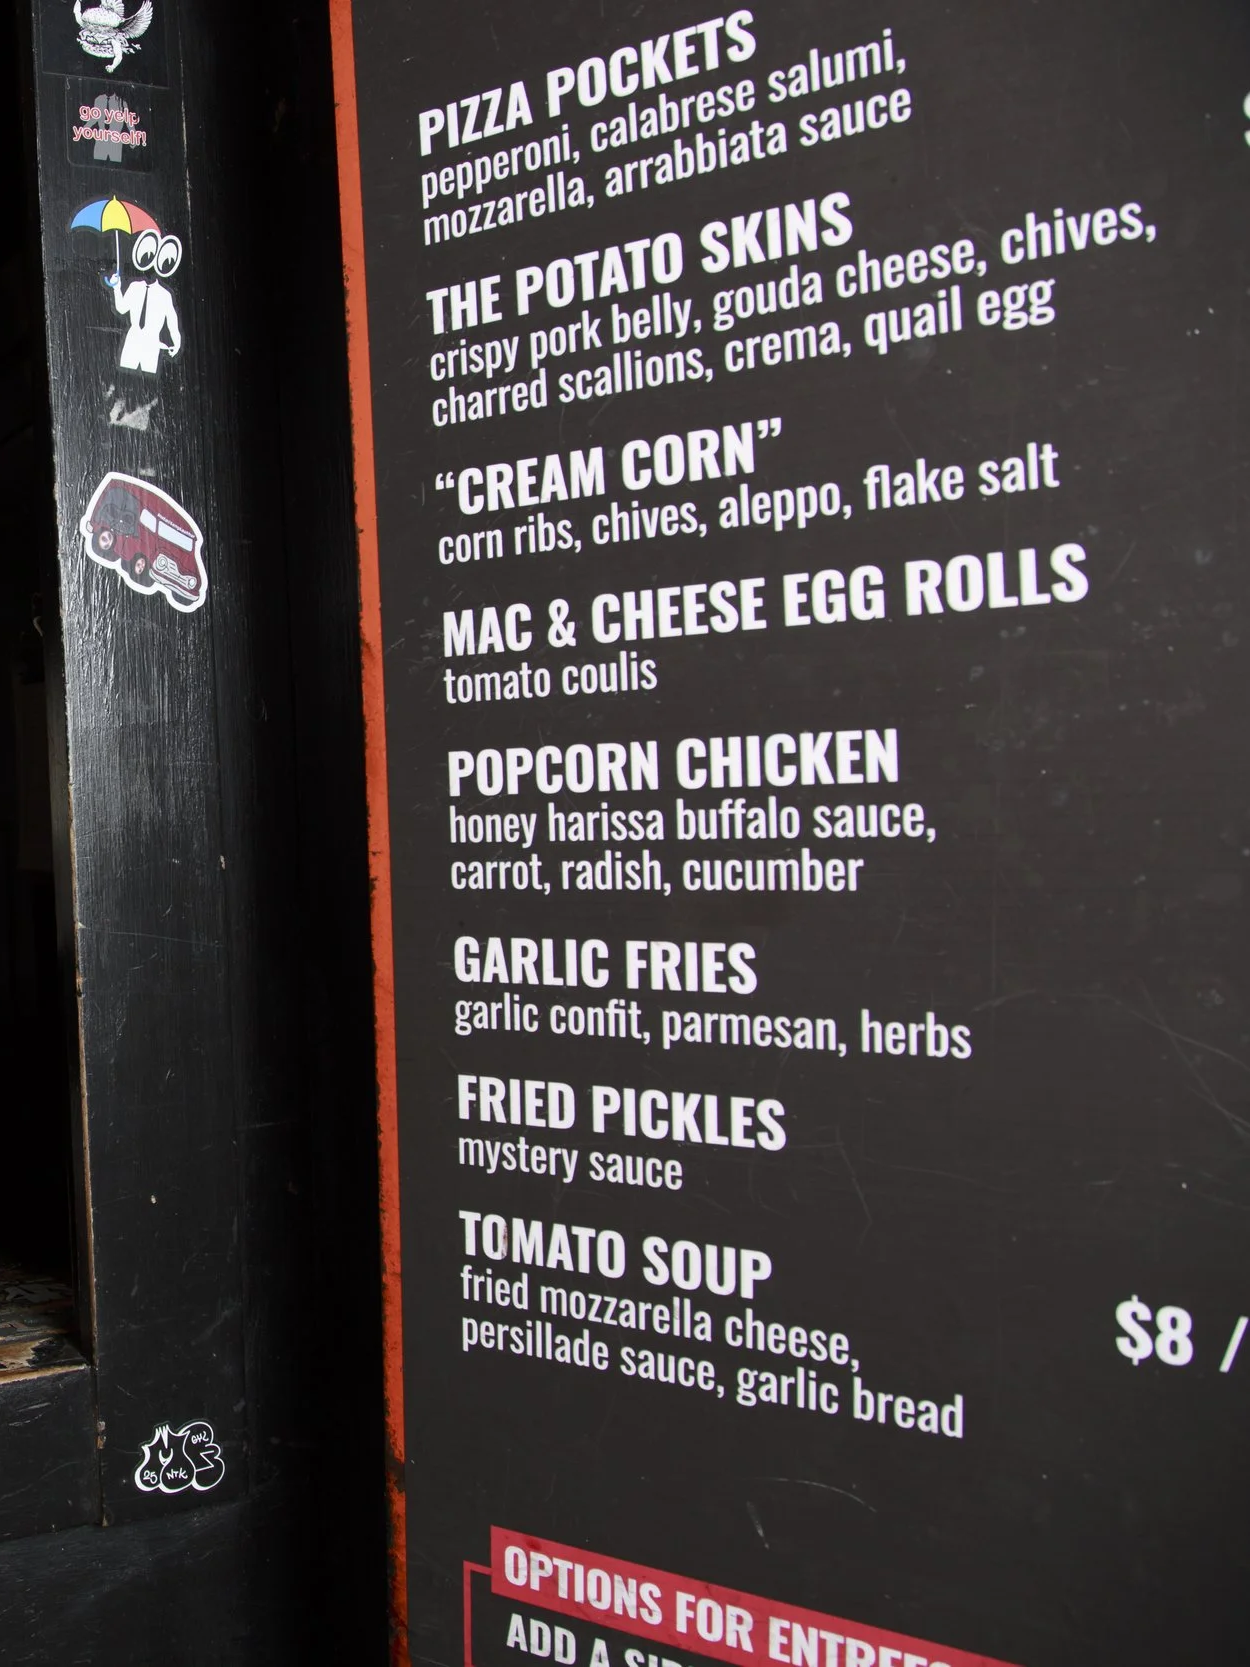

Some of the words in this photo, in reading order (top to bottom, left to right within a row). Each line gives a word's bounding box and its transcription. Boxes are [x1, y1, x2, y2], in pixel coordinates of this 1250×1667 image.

[79, 105, 101, 121] go
[104, 108, 141, 127] yelp
[418, 80, 534, 157] PIZZA
[546, 9, 757, 118] POCKETS
[421, 123, 580, 210] pepperoni,
[590, 79, 756, 153] calabrese
[767, 27, 906, 103] salumi,
[72, 126, 148, 147] yourself!
[423, 170, 595, 246] mozzarella,
[604, 120, 788, 198] arrabbiata
[798, 88, 912, 147] sauce
[425, 274, 503, 335] THE
[515, 232, 684, 316] POTATO
[699, 191, 853, 274] SKINS
[430, 335, 520, 382] crispy
[529, 309, 603, 370] pork
[611, 291, 702, 345] belly,
[712, 264, 823, 332] gouda
[835, 238, 987, 299] cheese,
[1000, 202, 1157, 265] chives,
[432, 367, 548, 427] charred
[558, 347, 714, 404] scallions,
[724, 321, 852, 373] crema,
[863, 284, 963, 356] quail
[976, 278, 1056, 331] egg
[438, 528, 504, 565] corn
[514, 512, 582, 556] ribs,
[591, 500, 708, 545] chives,
[718, 482, 852, 532] aleppo,
[862, 457, 965, 511] flake
[978, 441, 1061, 496] salt
[442, 602, 533, 658] MAC
[547, 598, 577, 648] &
[591, 576, 768, 644] CHEESE
[782, 564, 886, 627] EGG
[904, 542, 1089, 617] ROLLS
[443, 661, 551, 705] tomato
[561, 650, 658, 696] coulis
[447, 740, 659, 797] POPCORN
[676, 727, 899, 790] CHICKEN
[449, 804, 538, 849] honey
[547, 801, 665, 842] harissa
[675, 795, 801, 841] buffalo
[813, 802, 936, 844] sauce,
[450, 853, 551, 896] carrot,
[561, 849, 672, 897] radish,
[682, 847, 865, 892] cucumber
[453, 935, 610, 989] GARLIC
[625, 940, 758, 995] FRIES
[454, 991, 539, 1036] garlic
[549, 998, 651, 1045] confit,
[662, 1010, 847, 1058] parmesan,
[861, 1008, 972, 1060] herbs
[457, 1074, 576, 1130] FRIED
[592, 1085, 787, 1152] PICKLES
[458, 1136, 579, 1184] mystery
[589, 1151, 683, 1191] sauce
[458, 1209, 626, 1279] TOMATO
[642, 1235, 772, 1300] SOUP
[460, 1264, 529, 1310] fried
[540, 1285, 712, 1342] mozzarella
[724, 1307, 860, 1373] cheese,
[1115, 1294, 1194, 1366] $8
[462, 1317, 609, 1371] persillade
[620, 1346, 725, 1399] sauce,
[736, 1366, 839, 1415] garlic
[853, 1376, 964, 1439] bread
[504, 1545, 663, 1625] OPTIONS
[675, 1590, 754, 1653] FOR
[768, 1616, 951, 1667] ENTR
[506, 1613, 576, 1665] ADD
[588, 1637, 612, 1667] A
